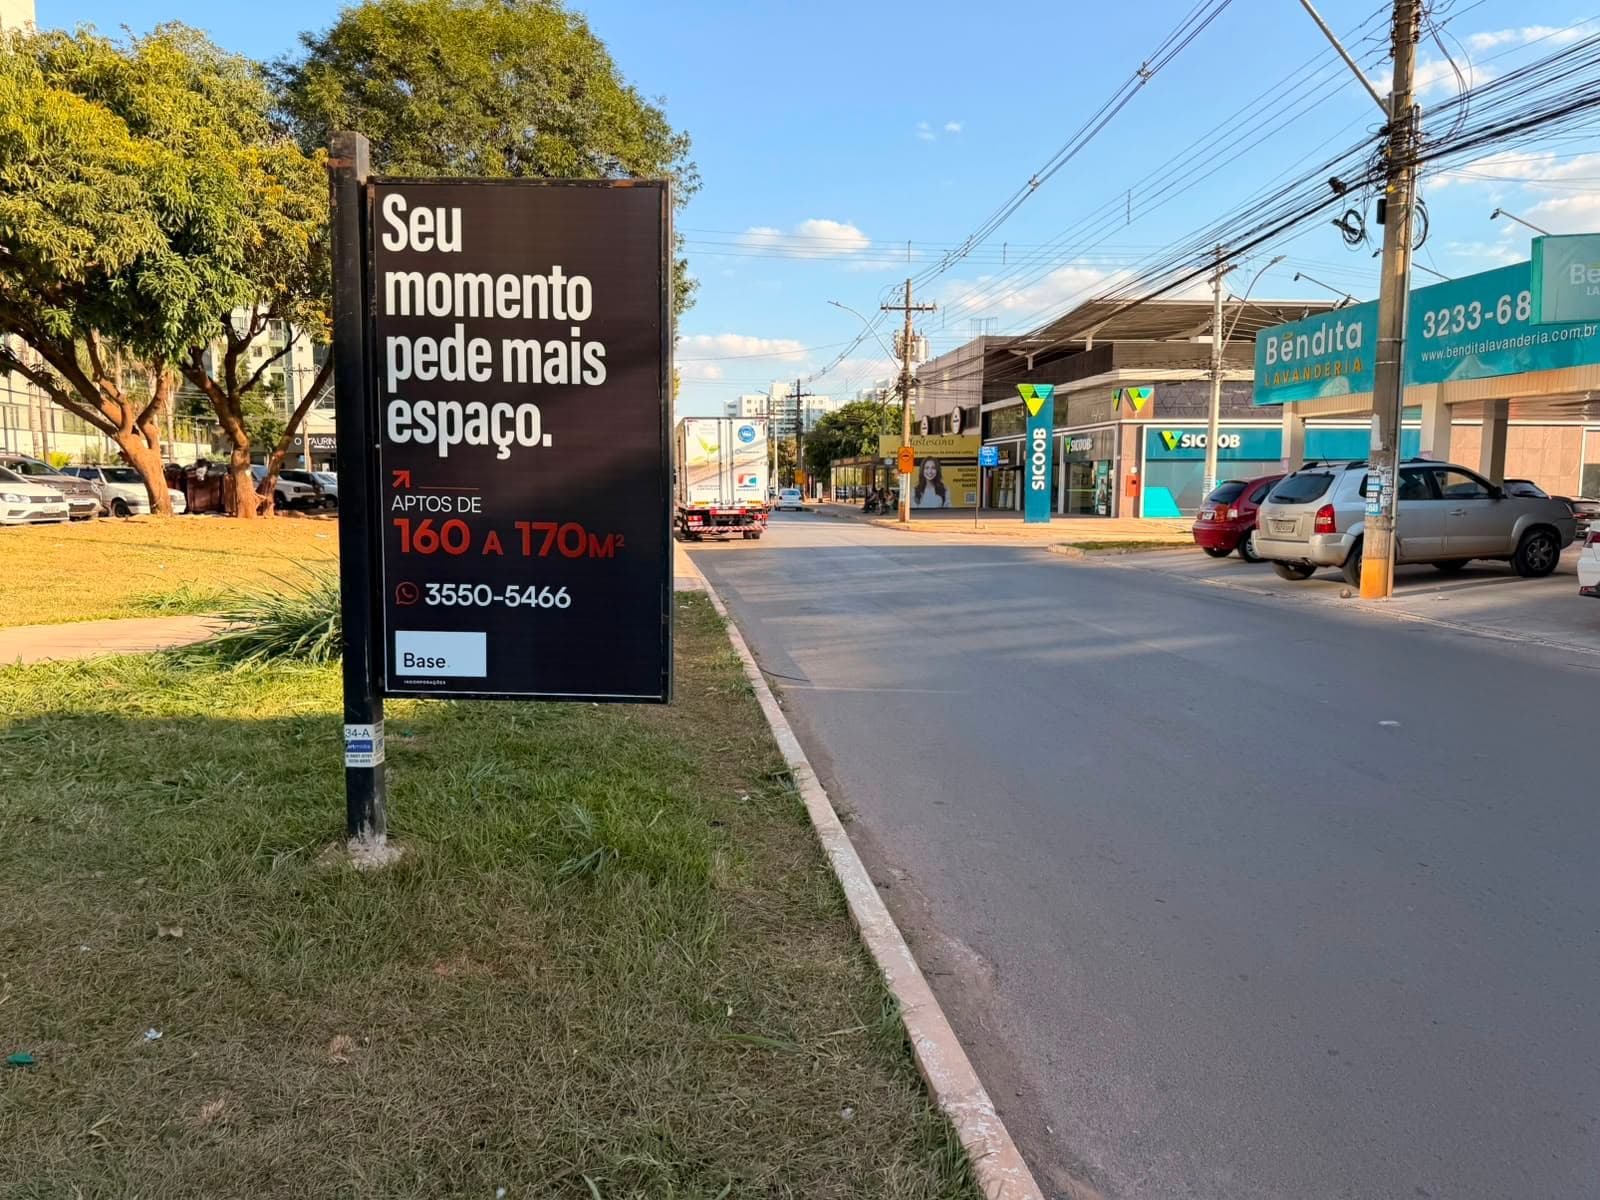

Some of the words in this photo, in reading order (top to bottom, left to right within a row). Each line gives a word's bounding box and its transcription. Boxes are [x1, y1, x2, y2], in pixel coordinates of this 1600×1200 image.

[381, 193, 463, 253] Seu
[384, 265, 593, 321] momento
[1422, 290, 1531, 338] 3233-68
[386, 323, 493, 394] pede
[502, 326, 607, 386] mais
[1265, 319, 1363, 365] Bendita
[1421, 323, 1598, 362] www.benditalavanderia.com.br
[1265, 356, 1363, 387] LAVANDERIA
[387, 399, 553, 460] espaço.
[1181, 433, 1241, 449] SICOB
[1031, 427, 1047, 491] SICOOB
[391, 494, 453, 513] APTOS
[457, 496, 482, 513] DE
[392, 517, 472, 556] 160
[483, 531, 504, 556] A
[424, 583, 572, 609] 3550-5466
